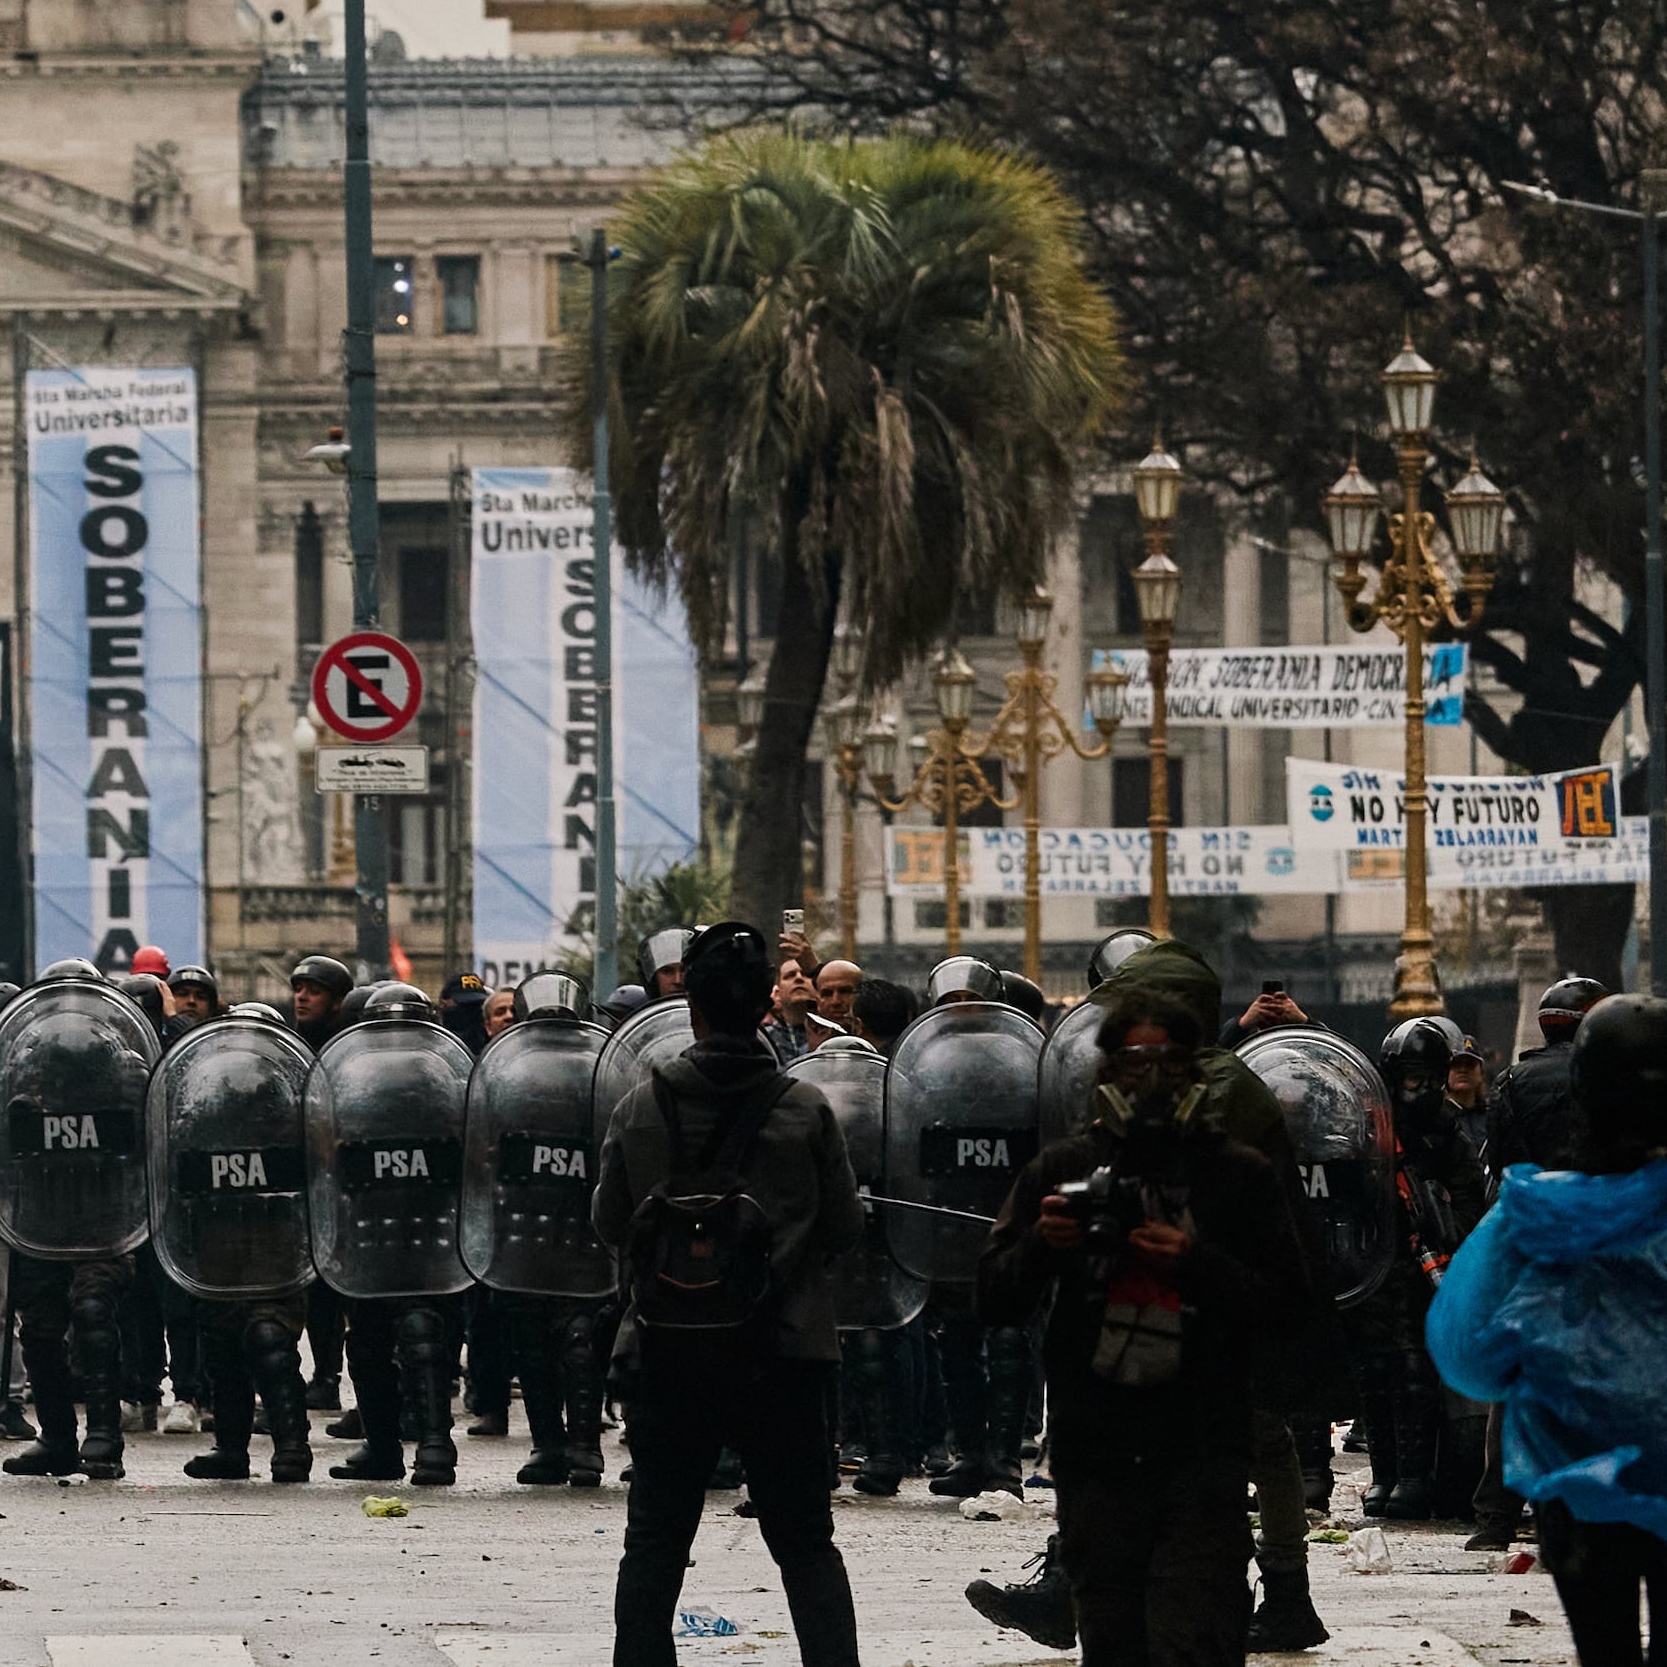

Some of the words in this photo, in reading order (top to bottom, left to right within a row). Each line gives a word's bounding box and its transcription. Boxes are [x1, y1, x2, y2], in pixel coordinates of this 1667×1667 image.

[128, 380, 189, 398] Federal
[34, 404, 190, 433] Universitaria
[522, 492, 593, 512] March
[1350, 795, 1385, 823] NO
[1396, 796, 1441, 824] HY
[1452, 796, 1540, 824] FUTURO
[43, 1115, 99, 1150] PSA
[374, 1149, 429, 1179] PSA
[533, 1145, 586, 1180] PSA
[956, 1138, 1010, 1168] PSA
[211, 1151, 267, 1189] PSA
